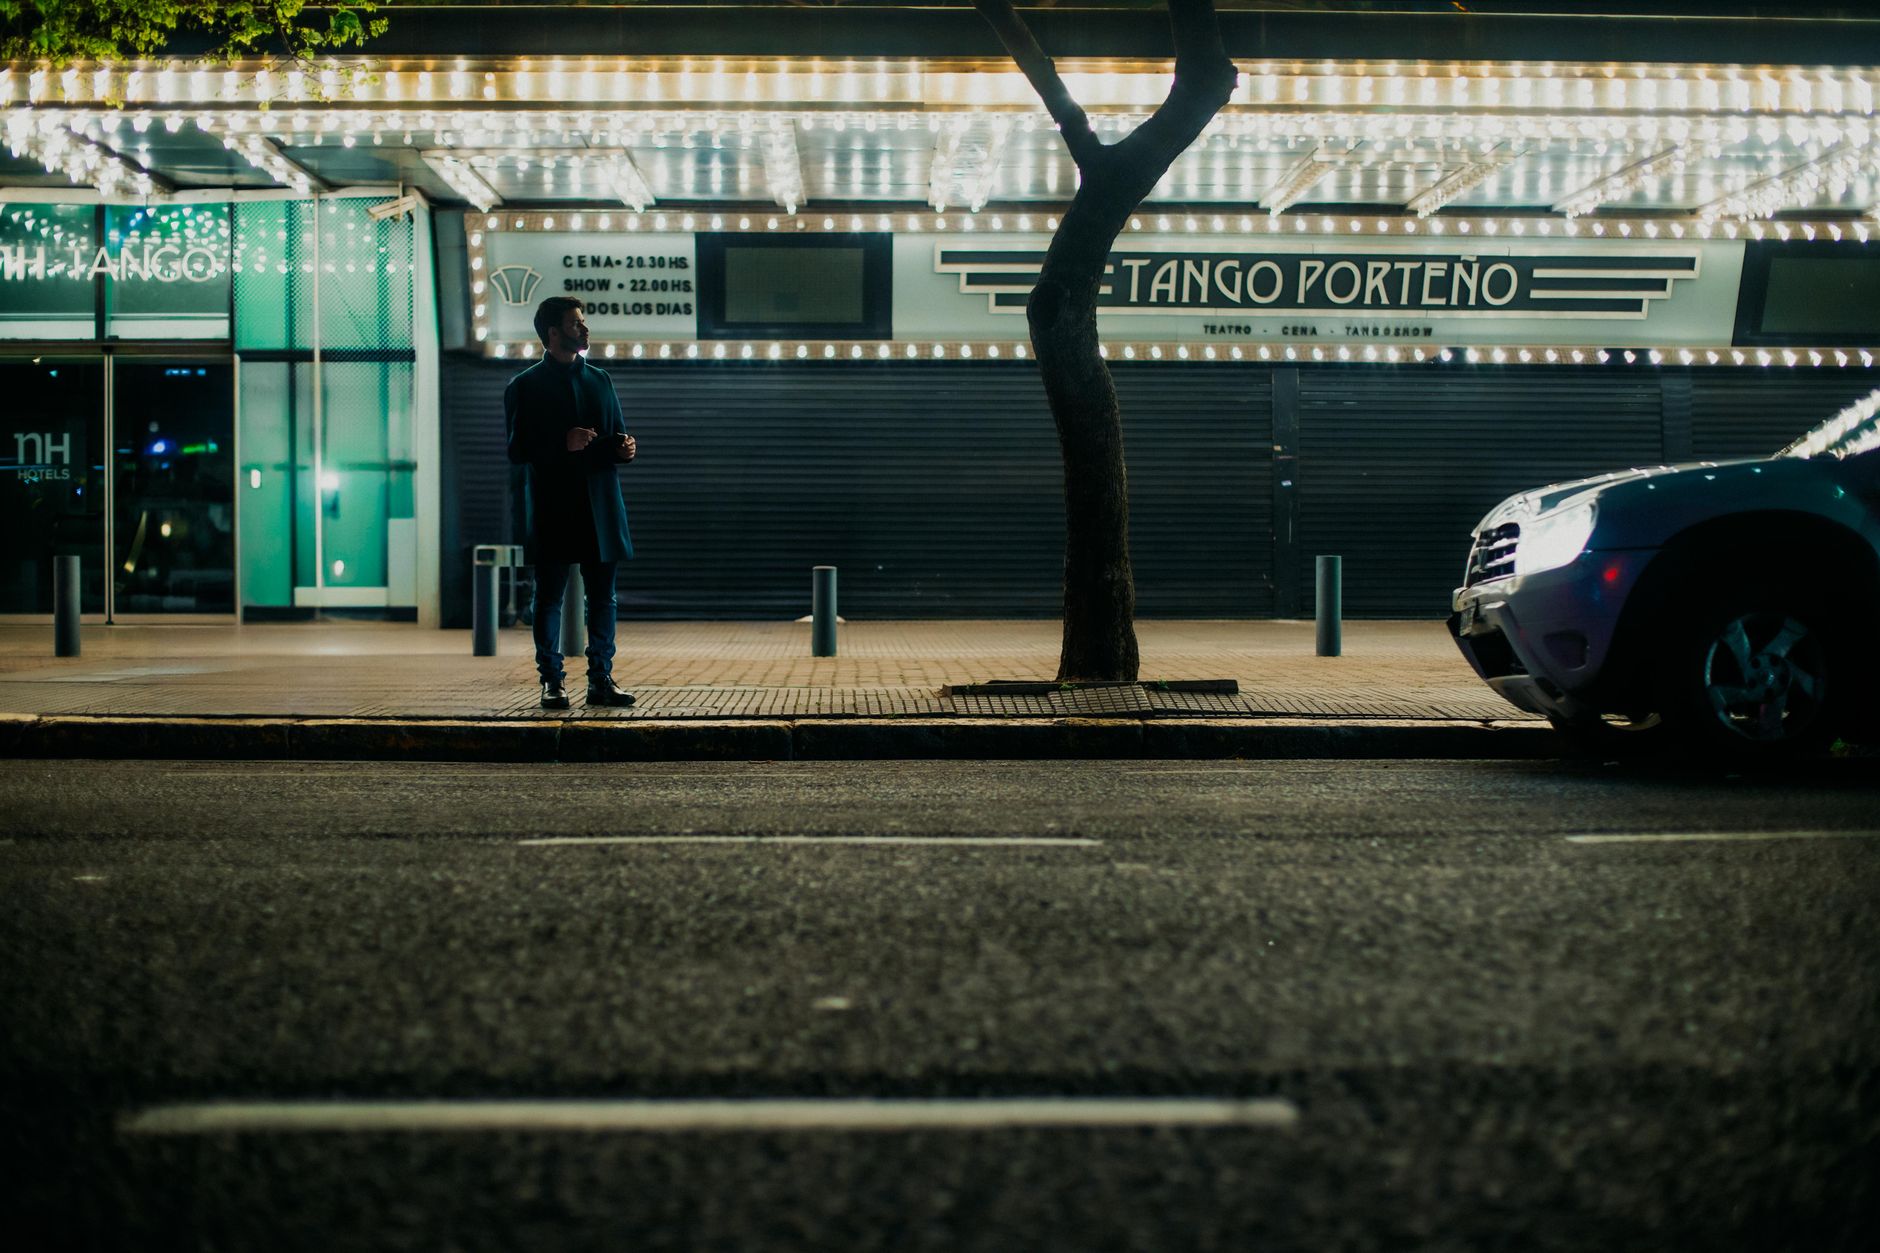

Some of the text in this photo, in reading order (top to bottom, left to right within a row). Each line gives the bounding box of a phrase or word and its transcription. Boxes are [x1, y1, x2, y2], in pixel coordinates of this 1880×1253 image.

[64, 246, 217, 282] TANGO
[563, 255, 614, 268] CENA
[563, 279, 610, 292] SHOW
[630, 279, 668, 292] 22.00
[1121, 255, 1518, 306] TANGO PORTEÑO
[580, 303, 692, 316] DOS LOS DIAS
[1203, 325, 1251, 335] TEATRO
[1282, 326, 1318, 336] CENA
[17, 468, 70, 480] HOTELS
